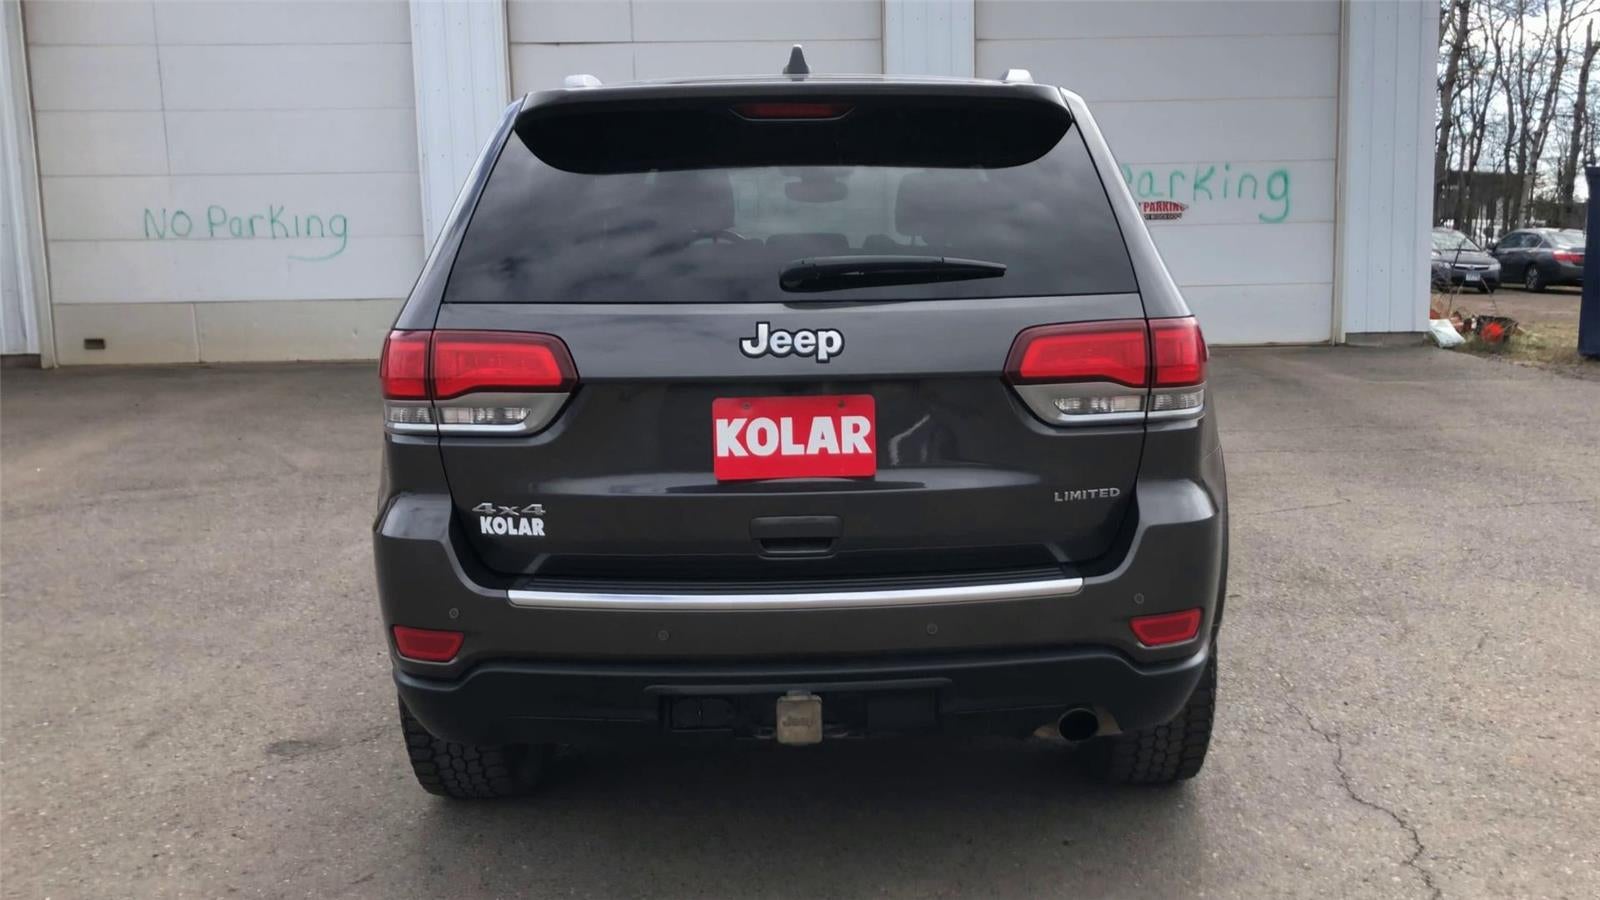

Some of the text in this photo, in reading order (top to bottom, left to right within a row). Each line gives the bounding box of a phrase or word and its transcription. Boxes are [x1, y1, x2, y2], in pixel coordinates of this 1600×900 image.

[739, 321, 845, 364] Jeep
[715, 415, 872, 458] KOLAR
[1053, 487, 1121, 503] LIMITED
[480, 515, 546, 537] KOLAR
